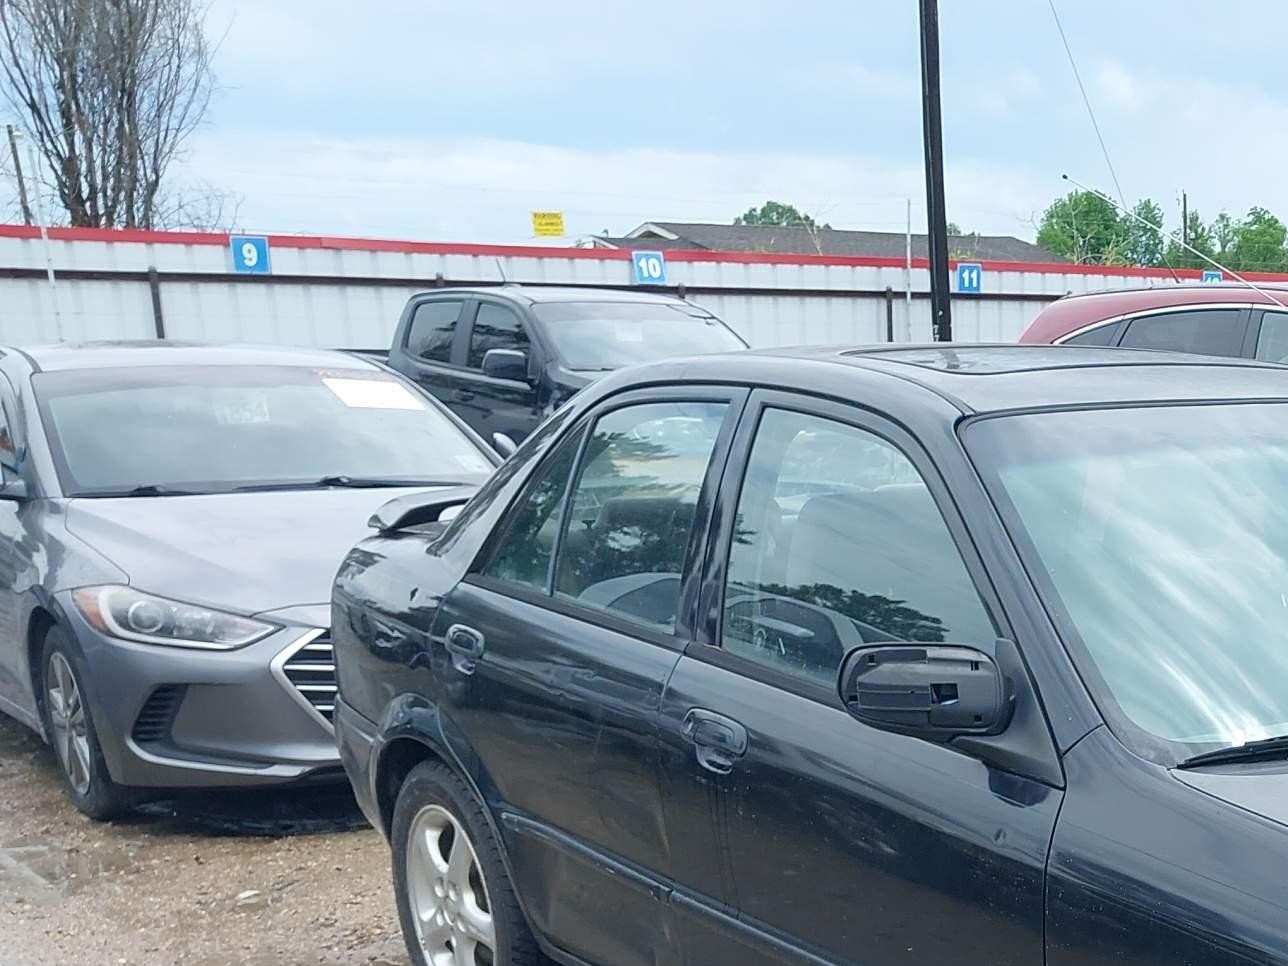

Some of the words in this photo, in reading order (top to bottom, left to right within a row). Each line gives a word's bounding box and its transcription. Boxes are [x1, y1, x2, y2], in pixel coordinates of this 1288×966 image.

[242, 243, 258, 267] 9
[638, 257, 661, 278] 10
[962, 269, 978, 288] 11
